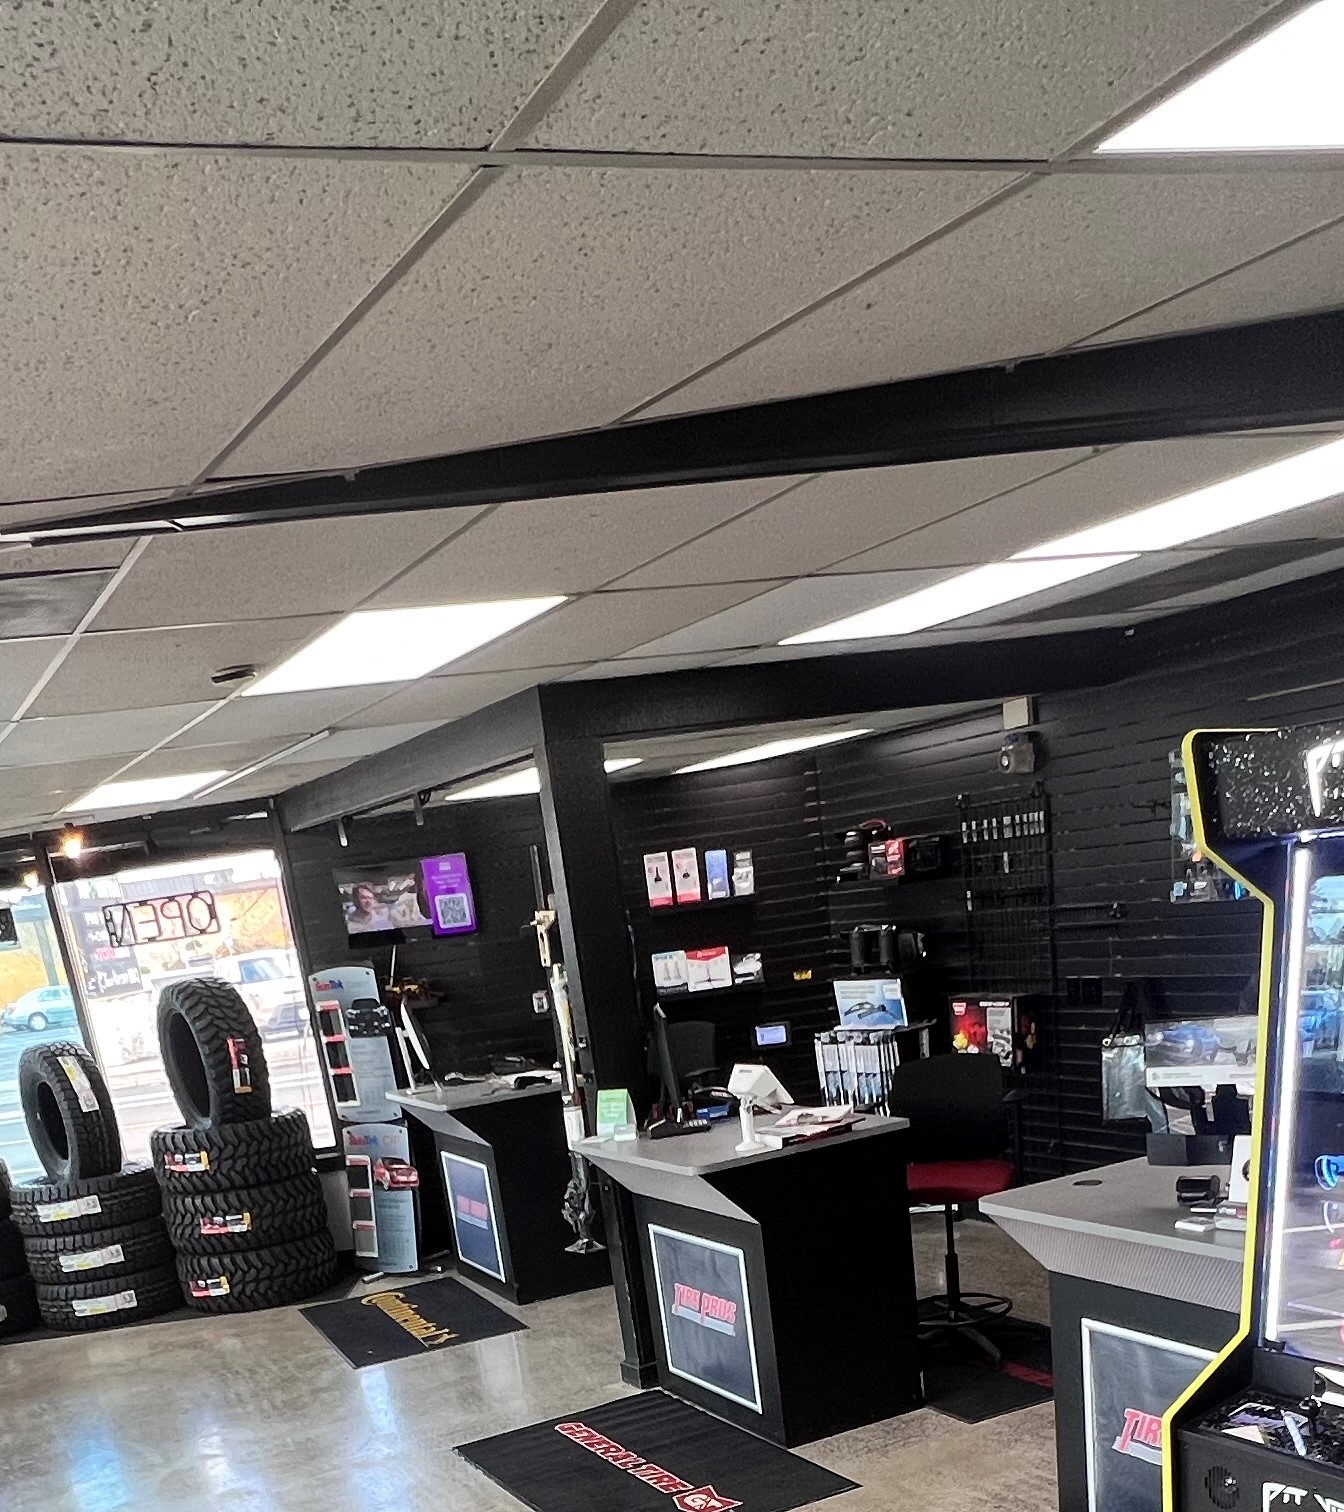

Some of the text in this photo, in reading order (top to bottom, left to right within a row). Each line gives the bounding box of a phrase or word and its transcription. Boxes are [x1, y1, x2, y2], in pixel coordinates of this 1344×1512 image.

[674, 1282, 737, 1325] TIRE PROS
[1119, 1408, 1163, 1451] TIR
[554, 1422, 646, 1470] GENERAL
[627, 1463, 696, 1494] TIRE
